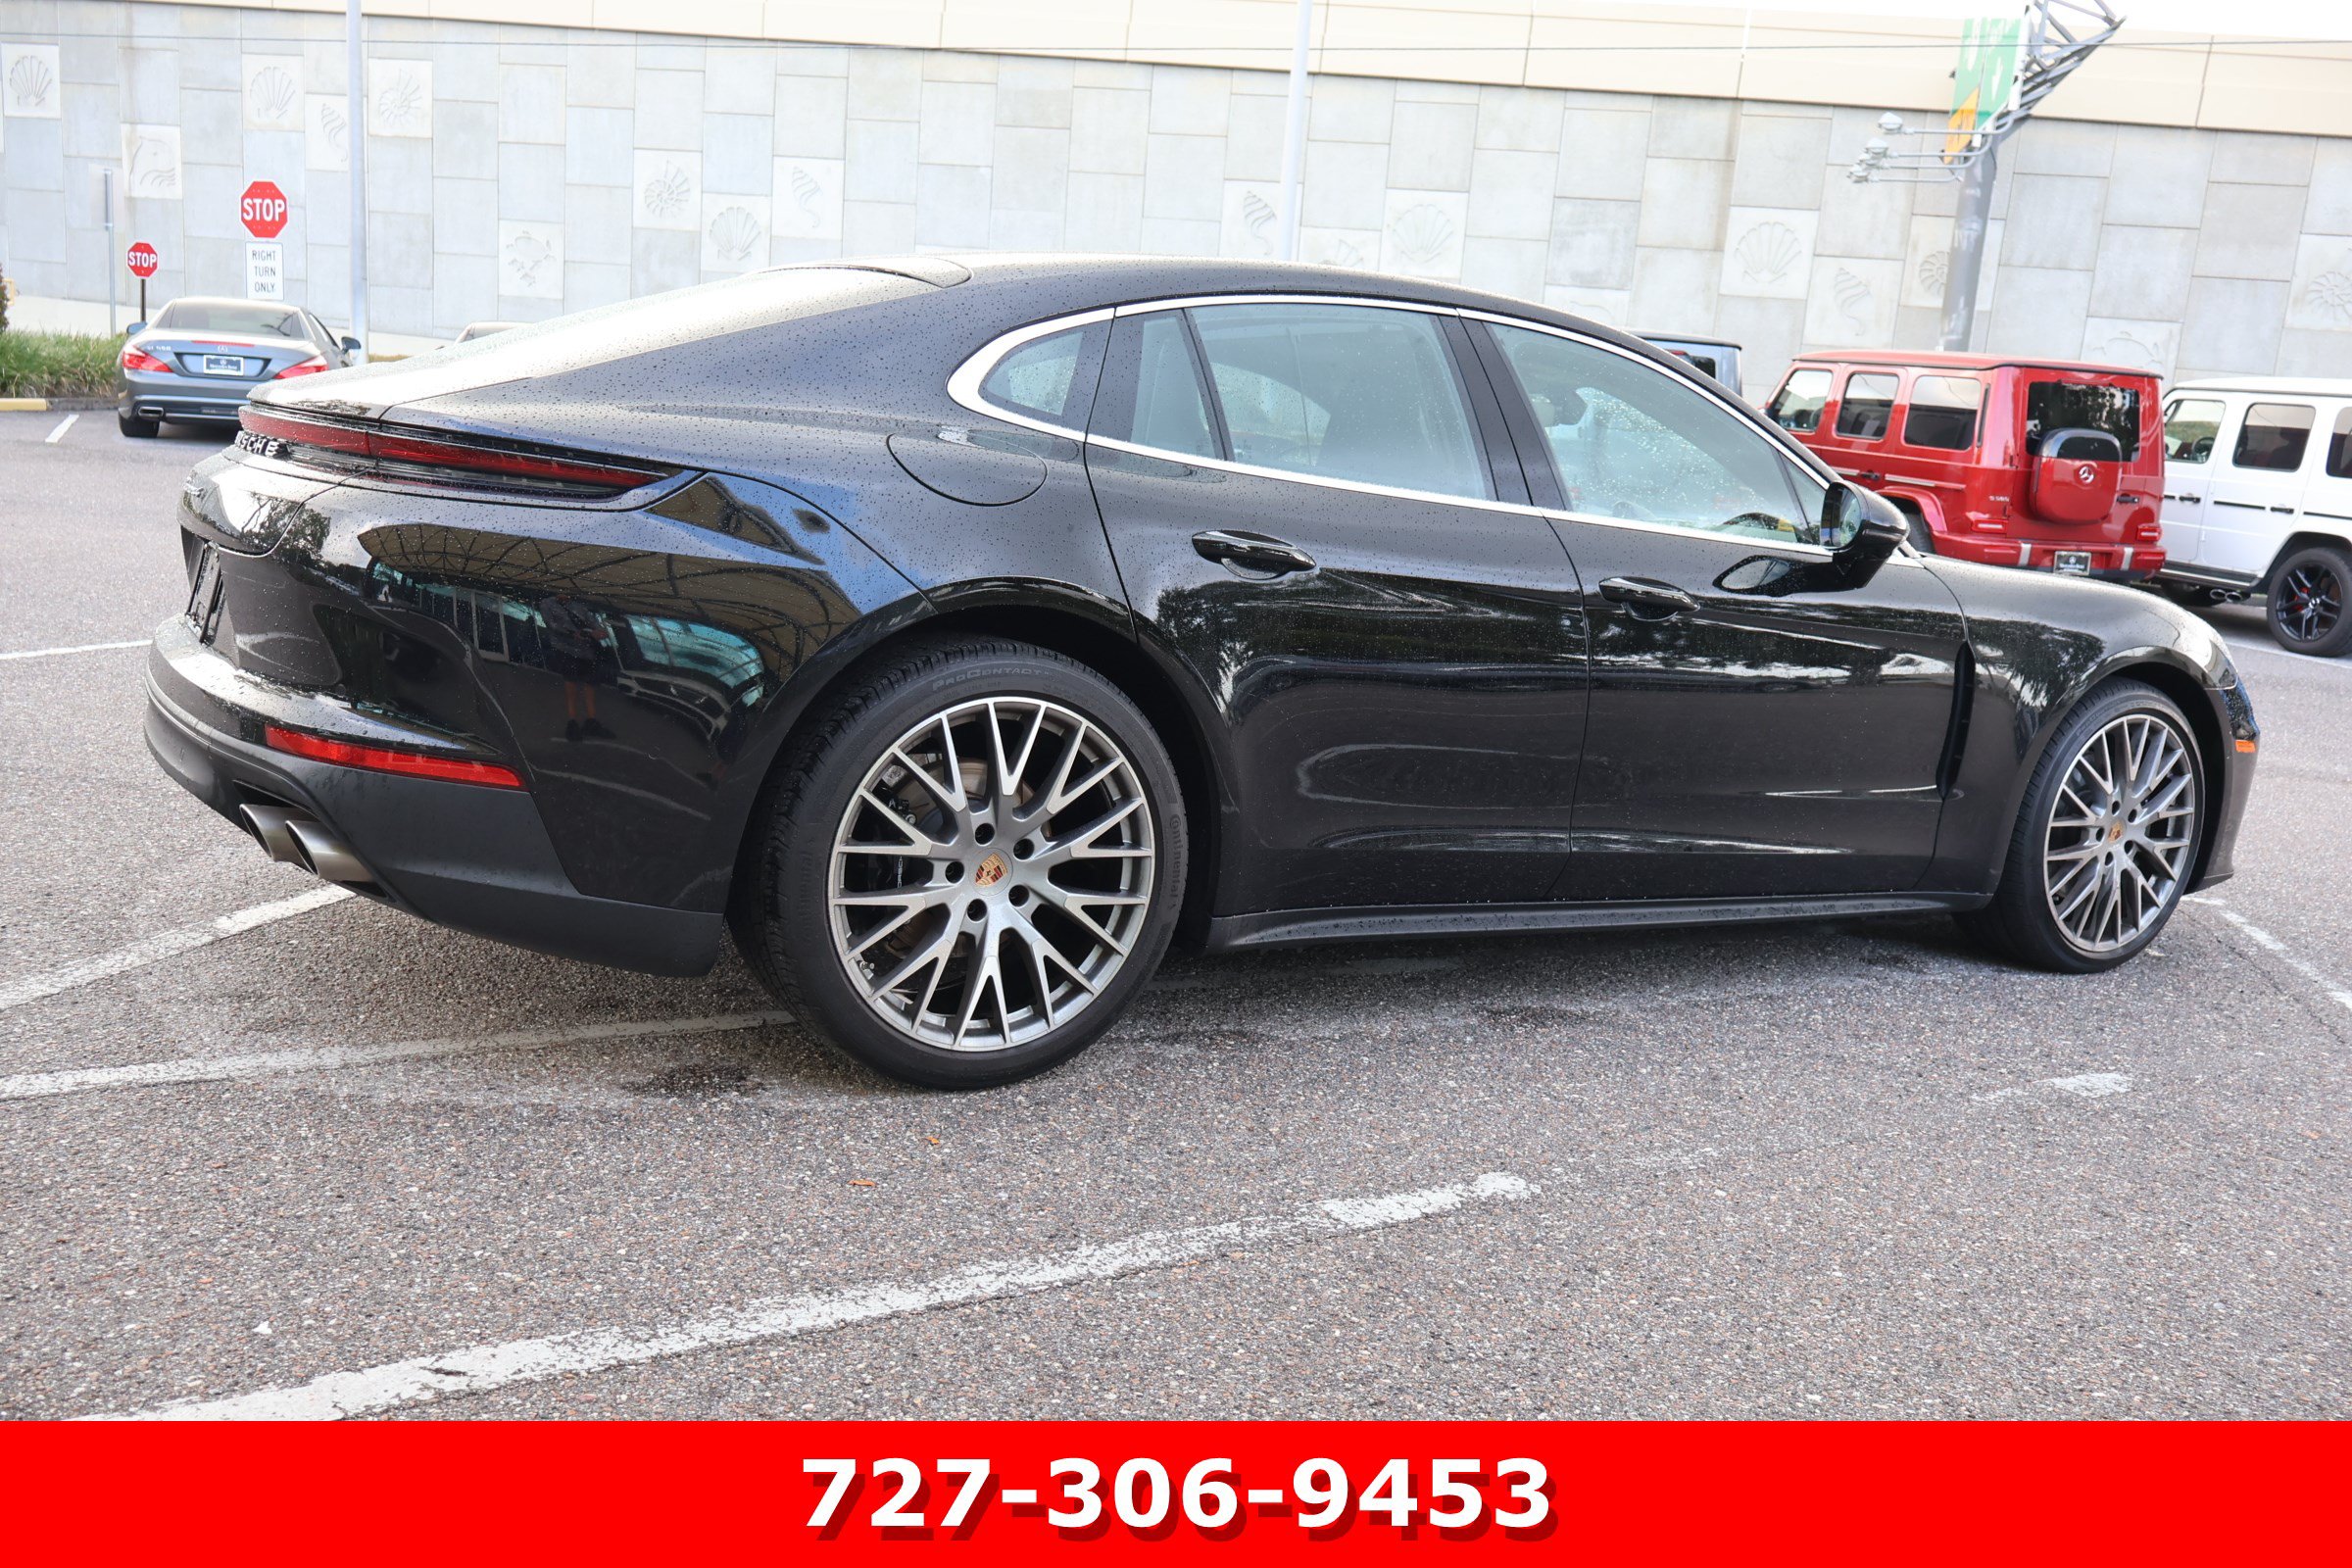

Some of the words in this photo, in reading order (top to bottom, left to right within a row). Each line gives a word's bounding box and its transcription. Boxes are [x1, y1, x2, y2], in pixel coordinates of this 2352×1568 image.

[242, 198, 285, 221] STOP
[128, 251, 157, 269] STOP
[252, 250, 276, 262] RIGHT
[255, 266, 276, 277] TURN
[255, 281, 275, 293] ONLY
